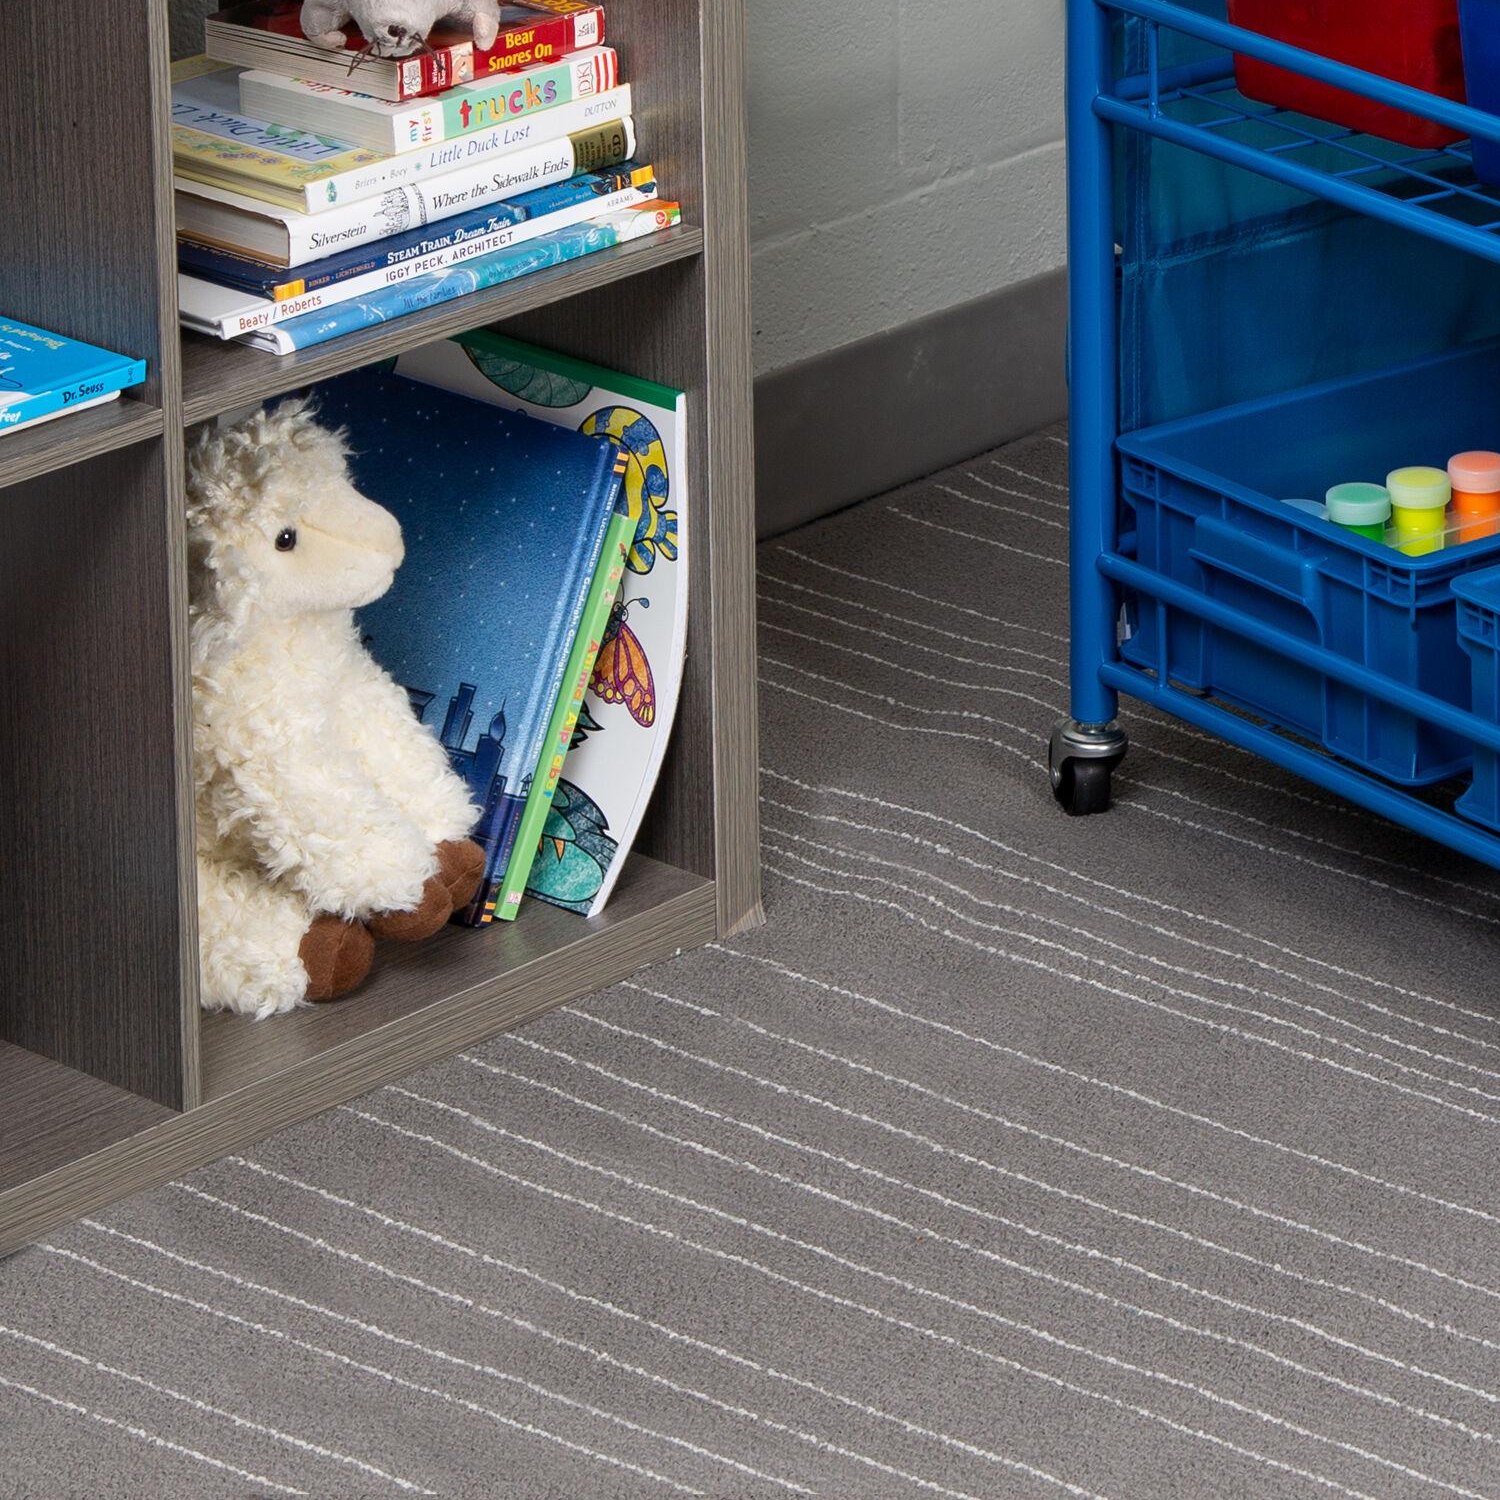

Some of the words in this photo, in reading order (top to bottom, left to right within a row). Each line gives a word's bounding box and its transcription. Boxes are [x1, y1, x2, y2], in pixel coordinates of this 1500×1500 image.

[505, 30, 536, 49] Bear
[488, 52, 532, 73] Snores
[534, 43, 553, 58] On
[577, 61, 595, 96] DK
[458, 77, 557, 129] trucks
[584, 99, 618, 118] DUTTON
[408, 119, 420, 142] my
[420, 109, 433, 143] first
[429, 144, 464, 169] Little
[467, 136, 499, 157] Duck
[503, 124, 531, 145] Lost
[432, 192, 469, 211] Where
[470, 182, 490, 199] the
[491, 166, 540, 193] Sidewalk
[542, 156, 571, 178] Ends
[308, 222, 368, 250] Silverstein
[386, 246, 420, 266] STEAM
[453, 223, 487, 244] Dream
[238, 311, 270, 331] Beaty
[281, 293, 323, 317] Roberts
[385, 266, 411, 283] IGGY
[452, 230, 514, 261] ARCHITECT
[61, 390, 78, 405] Dr.
[78, 382, 105, 398] Seuss
[572, 639, 600, 705] Animal
